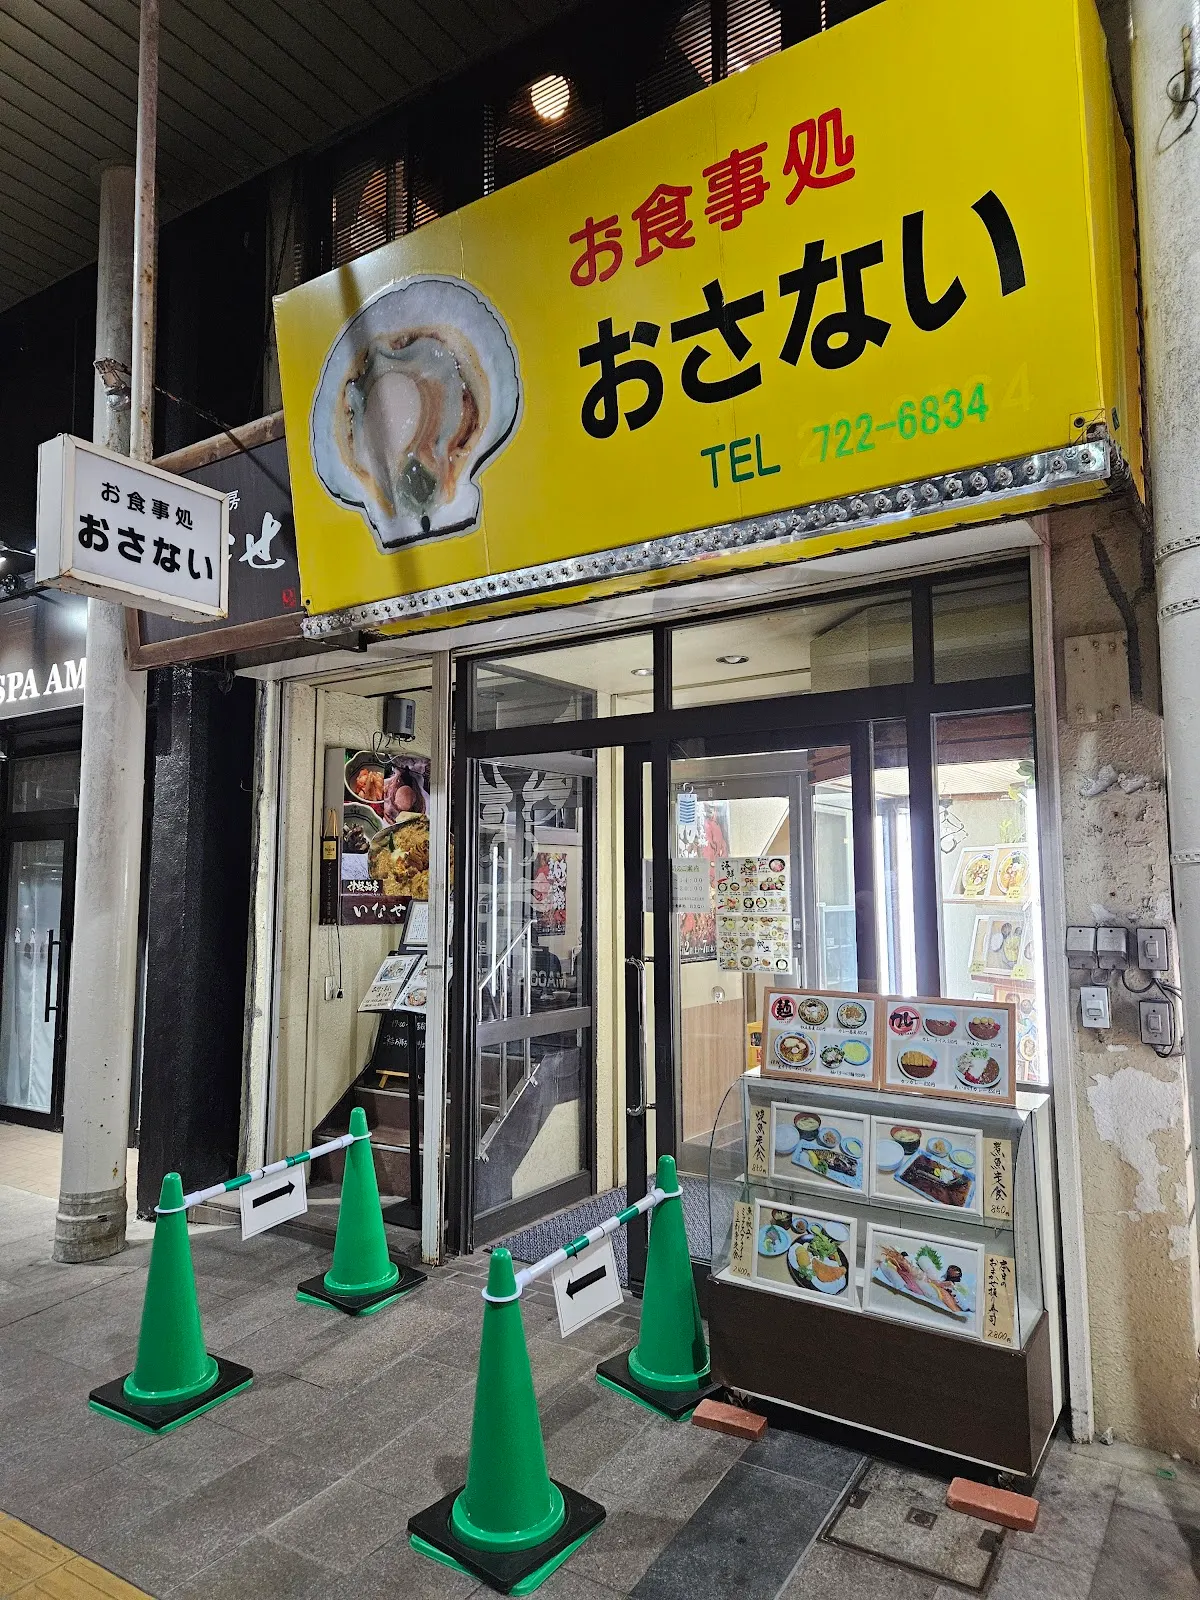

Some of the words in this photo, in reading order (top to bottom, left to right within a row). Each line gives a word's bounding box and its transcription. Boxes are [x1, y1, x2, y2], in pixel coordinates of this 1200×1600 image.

[569, 108, 856, 287] お食事処
[579, 190, 1027, 439] おさない
[700, 434, 781, 488] TEL
[812, 383, 990, 463] 722-6834
[78, 513, 214, 581] おさない
[100, 482, 194, 531] お食事処
